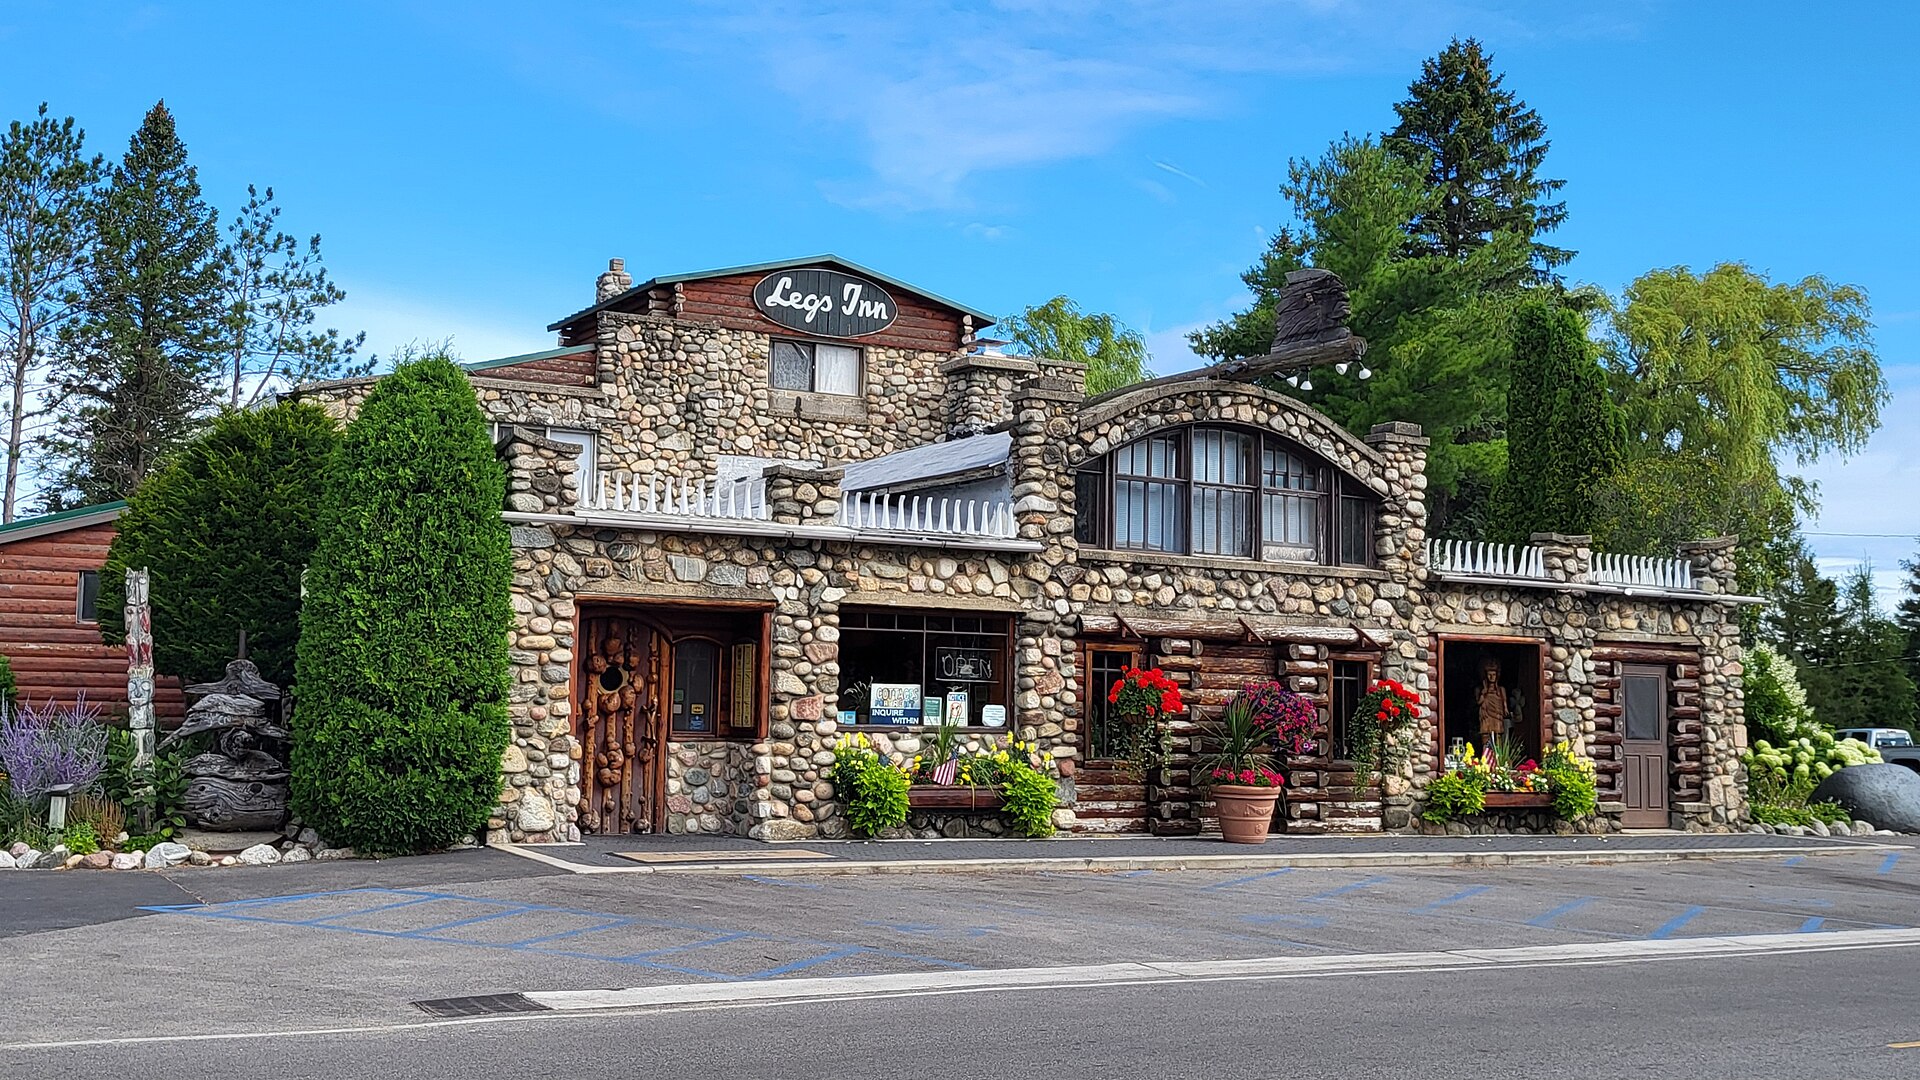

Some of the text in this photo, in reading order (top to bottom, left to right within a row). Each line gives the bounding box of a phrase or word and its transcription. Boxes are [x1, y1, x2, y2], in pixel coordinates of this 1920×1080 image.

[765, 277, 888, 323] Legs Inn
[942, 654, 992, 679] OPEN
[876, 687, 919, 701] COTTAGES
[872, 709, 904, 717] INQUIRE
[891, 717, 919, 725] WITHIN
